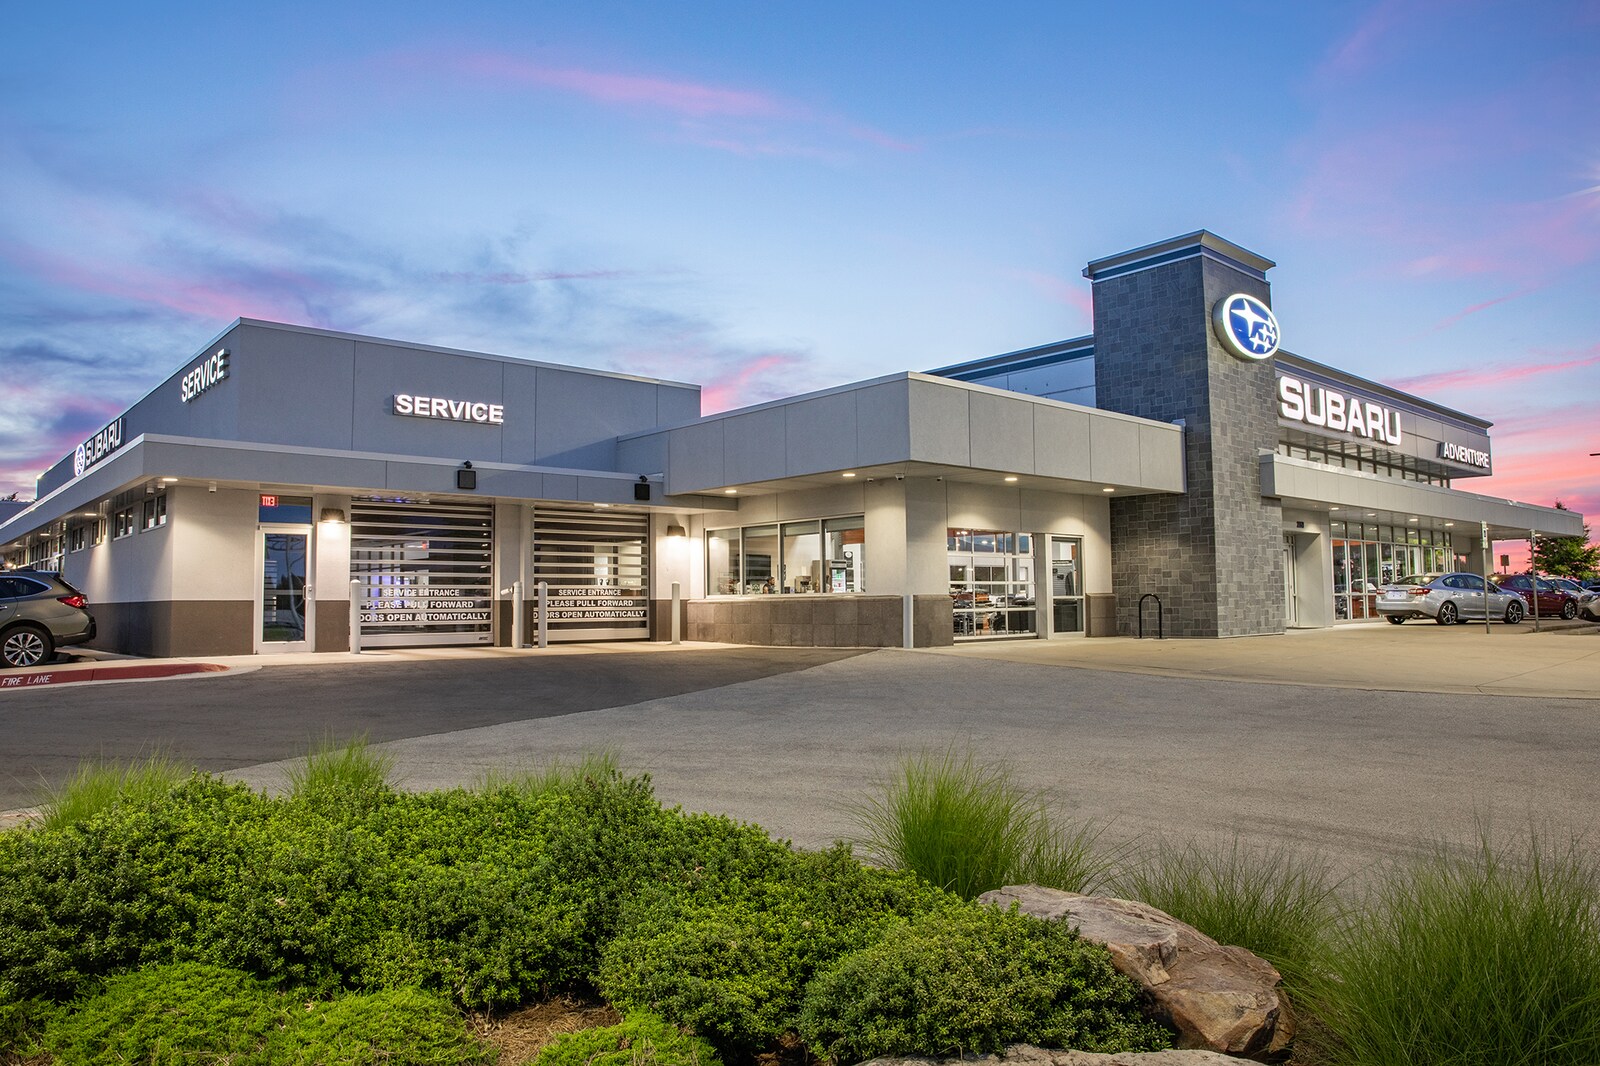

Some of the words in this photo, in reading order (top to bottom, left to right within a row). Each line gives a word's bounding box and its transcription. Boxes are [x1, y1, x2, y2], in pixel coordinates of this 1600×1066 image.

[181, 348, 225, 403] SERVICE
[395, 394, 504, 424] SERVICE
[1279, 375, 1401, 446] SUBARU
[85, 417, 122, 467] SUBARU
[1443, 441, 1490, 469] ADVENTURE
[383, 588, 417, 597] SERVICE
[418, 588, 460, 597] ENTRANCE
[366, 600, 402, 609] PLEASE
[584, 610, 645, 618] AUTOMATICALLY
[386, 613, 413, 621] OPEN
[414, 612, 488, 621] AUTOMATICALLY
[1, 676, 24, 687] FIRE
[27, 674, 53, 685] LANE
